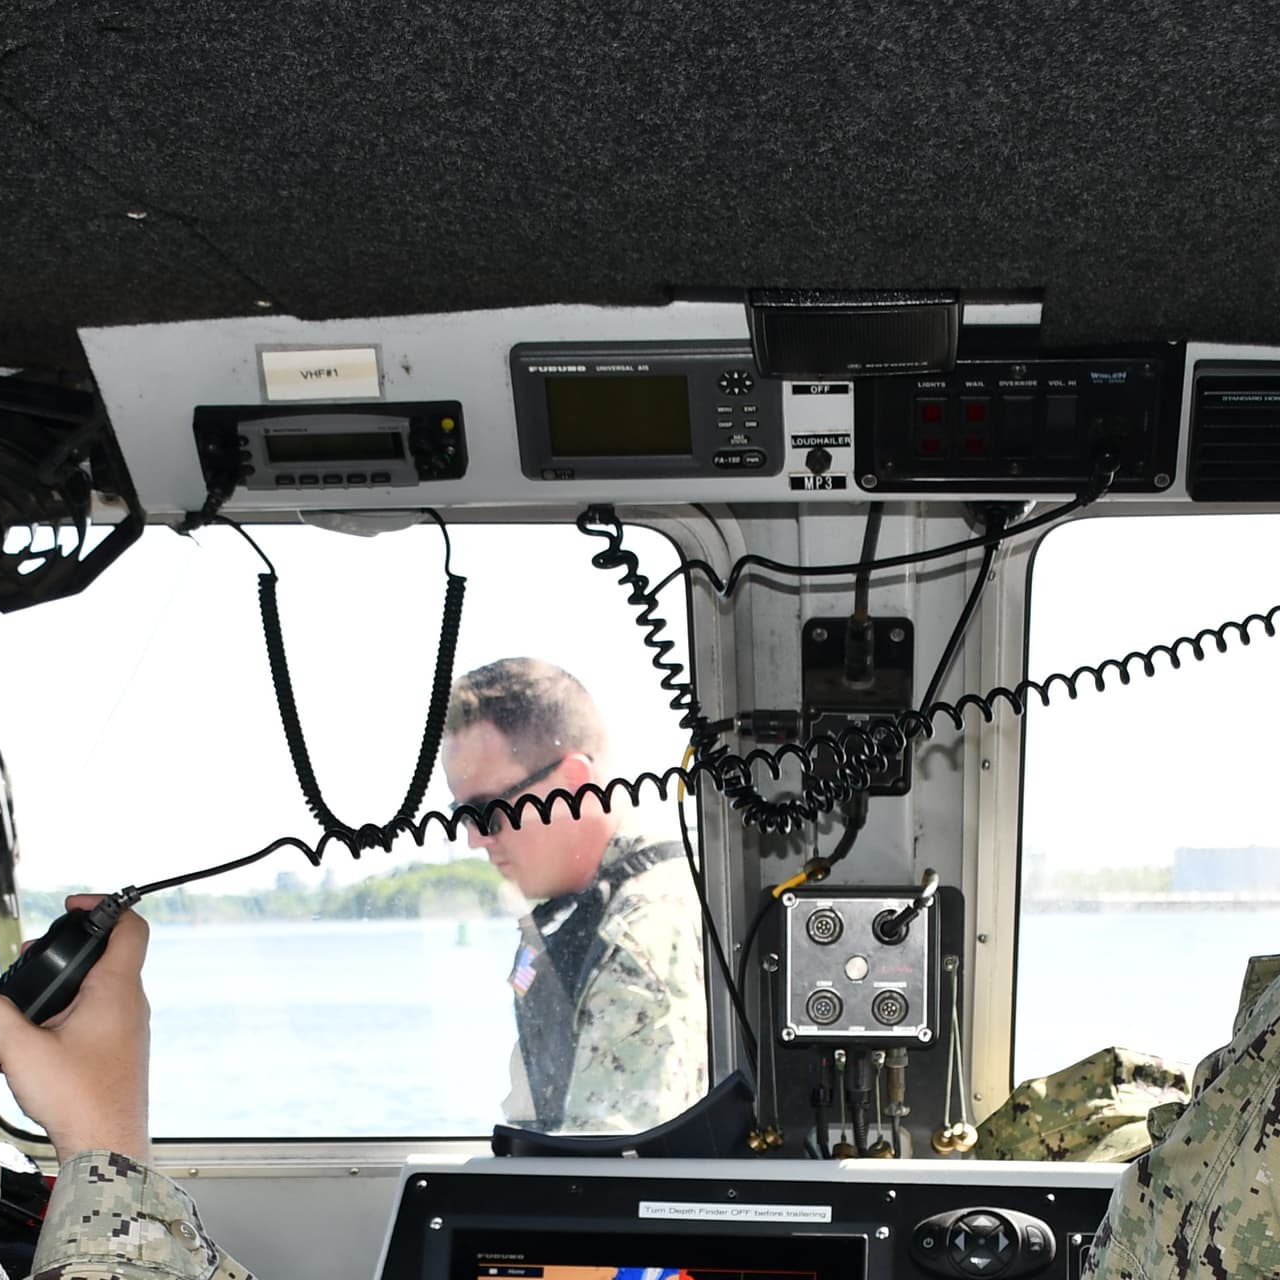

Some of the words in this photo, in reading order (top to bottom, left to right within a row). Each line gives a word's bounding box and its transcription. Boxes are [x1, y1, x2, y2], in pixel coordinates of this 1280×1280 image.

[299, 368, 339, 380] VHF#1
[528, 365, 586, 373] FURUNO
[810, 385, 830, 394] OFF
[792, 437, 851, 446] LOUDHAILER
[804, 477, 832, 490] MP3
[645, 1206, 666, 1214] Turn
[669, 1207, 696, 1216] Depth
[698, 1207, 727, 1216] Finder
[730, 1208, 751, 1217] OFF
[754, 1209, 784, 1217] before
[786, 1210, 827, 1219] trailering
